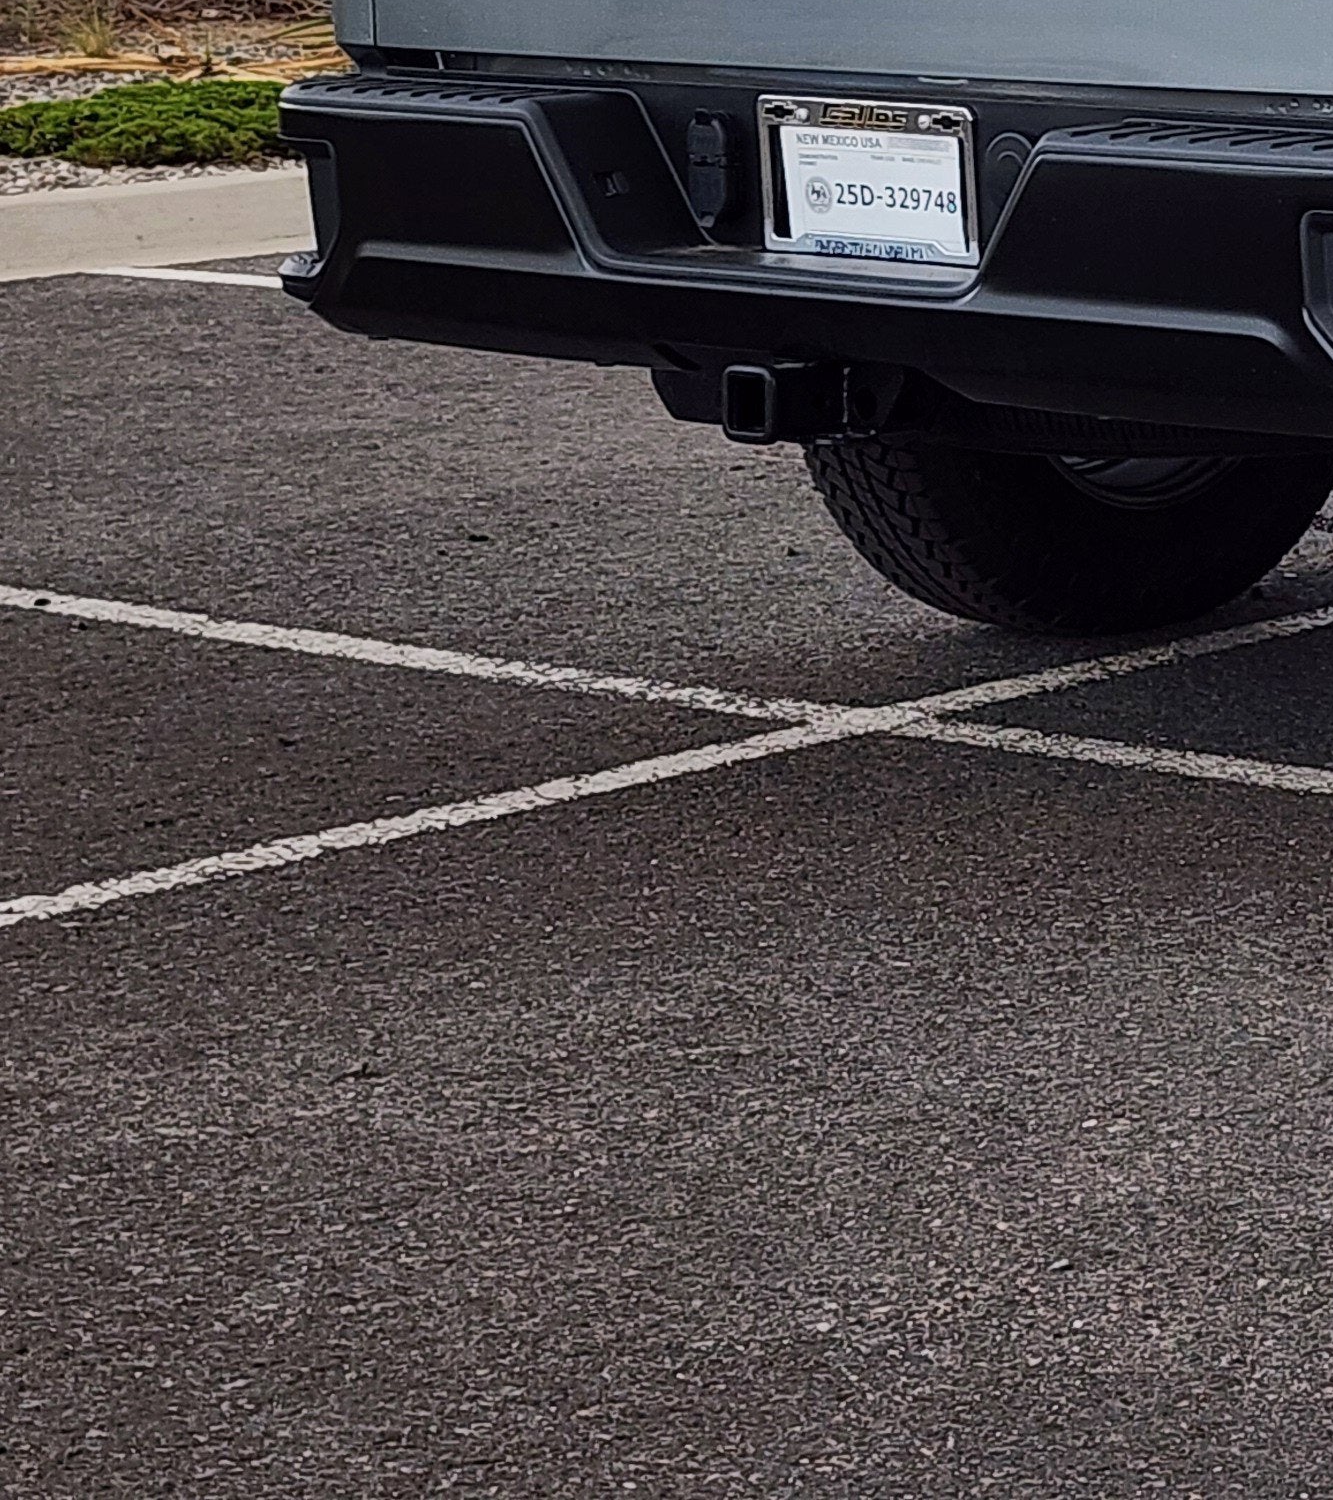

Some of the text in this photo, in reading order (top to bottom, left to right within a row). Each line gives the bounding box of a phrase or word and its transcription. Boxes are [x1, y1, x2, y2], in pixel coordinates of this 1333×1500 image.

[796, 133, 819, 145] NEW
[821, 134, 859, 148] MEXICO
[860, 136, 882, 149] USA
[834, 183, 958, 215] 25D-329748
